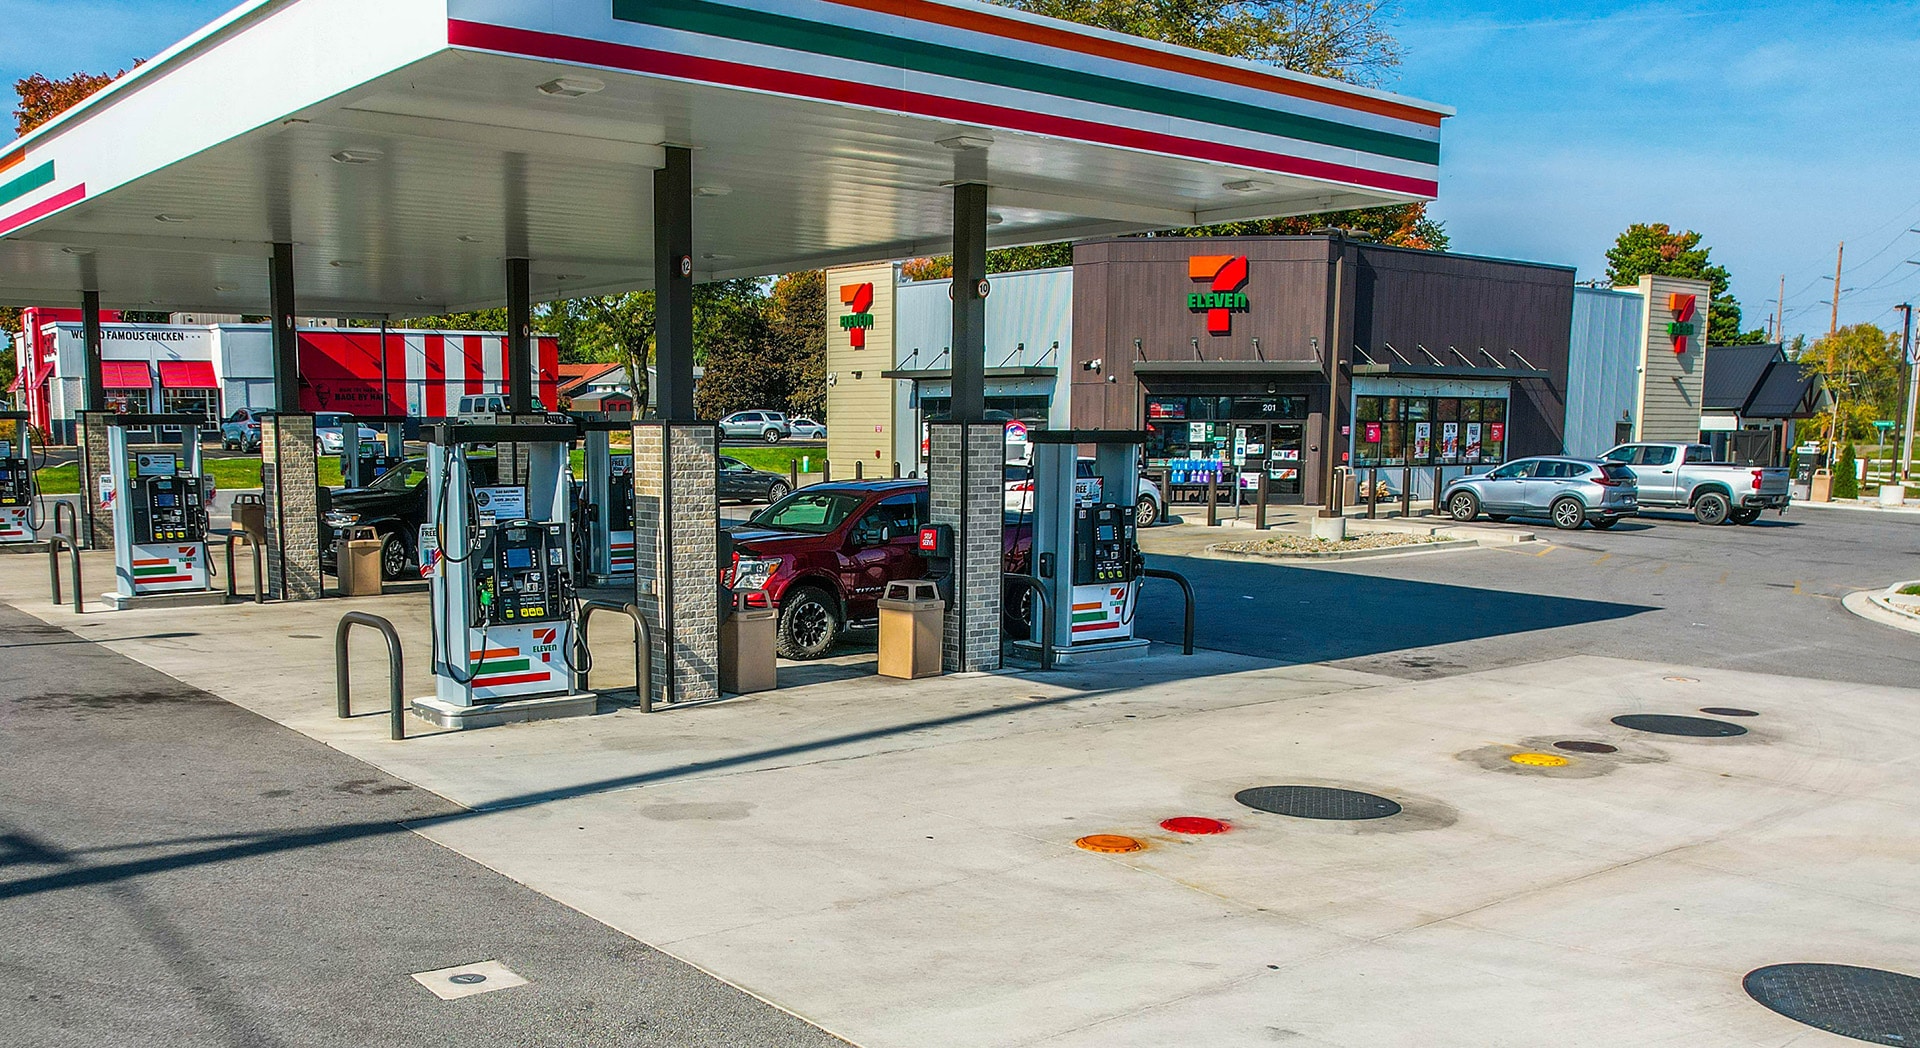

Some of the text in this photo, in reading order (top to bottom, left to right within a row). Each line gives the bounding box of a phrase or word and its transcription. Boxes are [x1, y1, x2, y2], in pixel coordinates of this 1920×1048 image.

[683, 261, 690, 271] 12
[1188, 255, 1249, 335] 7
[840, 282, 873, 348] 7
[1669, 293, 1696, 353] 7
[106, 330, 145, 341] FAMOUS
[146, 331, 184, 341] CHICKEN
[1262, 404, 1276, 412] 201
[1076, 485, 1087, 493] REE
[178, 546, 196, 569] 7
[533, 627, 557, 663] 7
